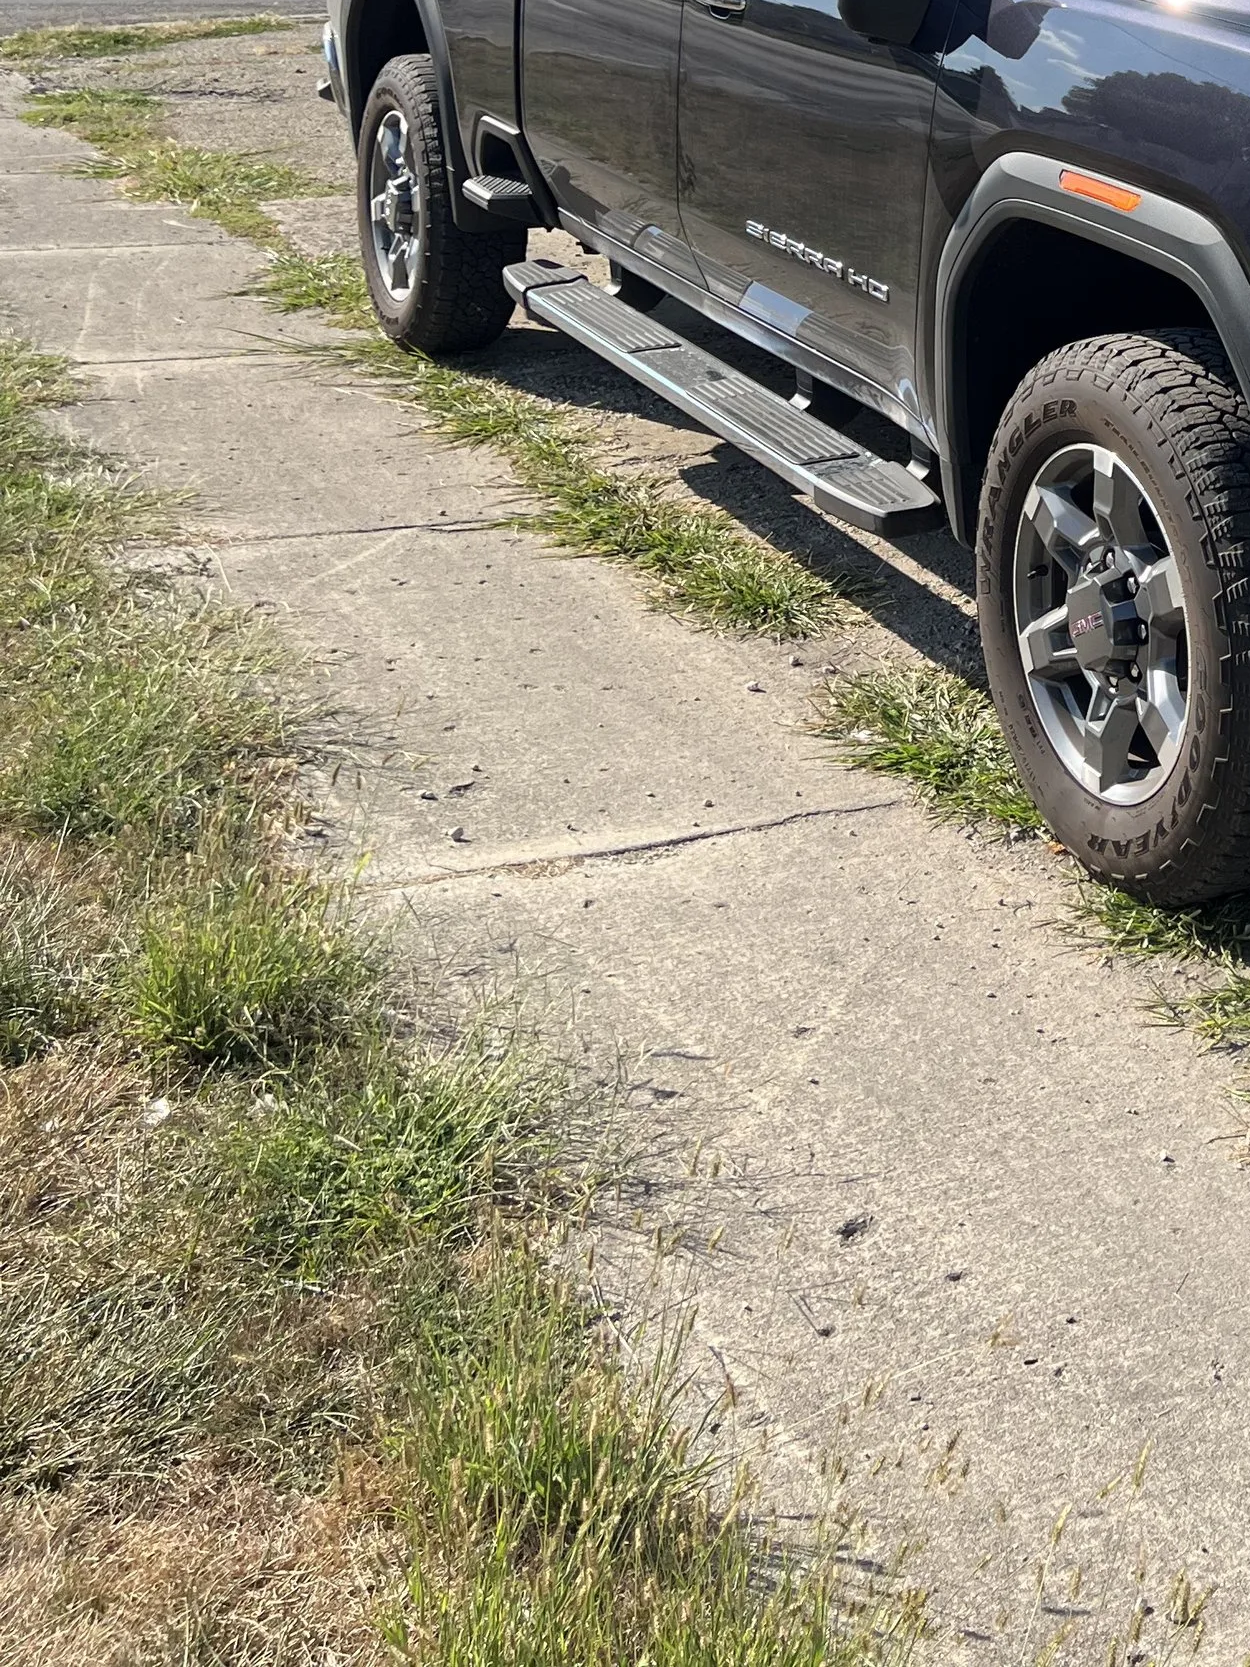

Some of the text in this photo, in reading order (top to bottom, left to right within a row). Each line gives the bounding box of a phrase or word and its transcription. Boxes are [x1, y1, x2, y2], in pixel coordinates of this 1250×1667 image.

[746, 220, 890, 302] SIERRA HD
[980, 399, 1078, 595] WRANGLER
